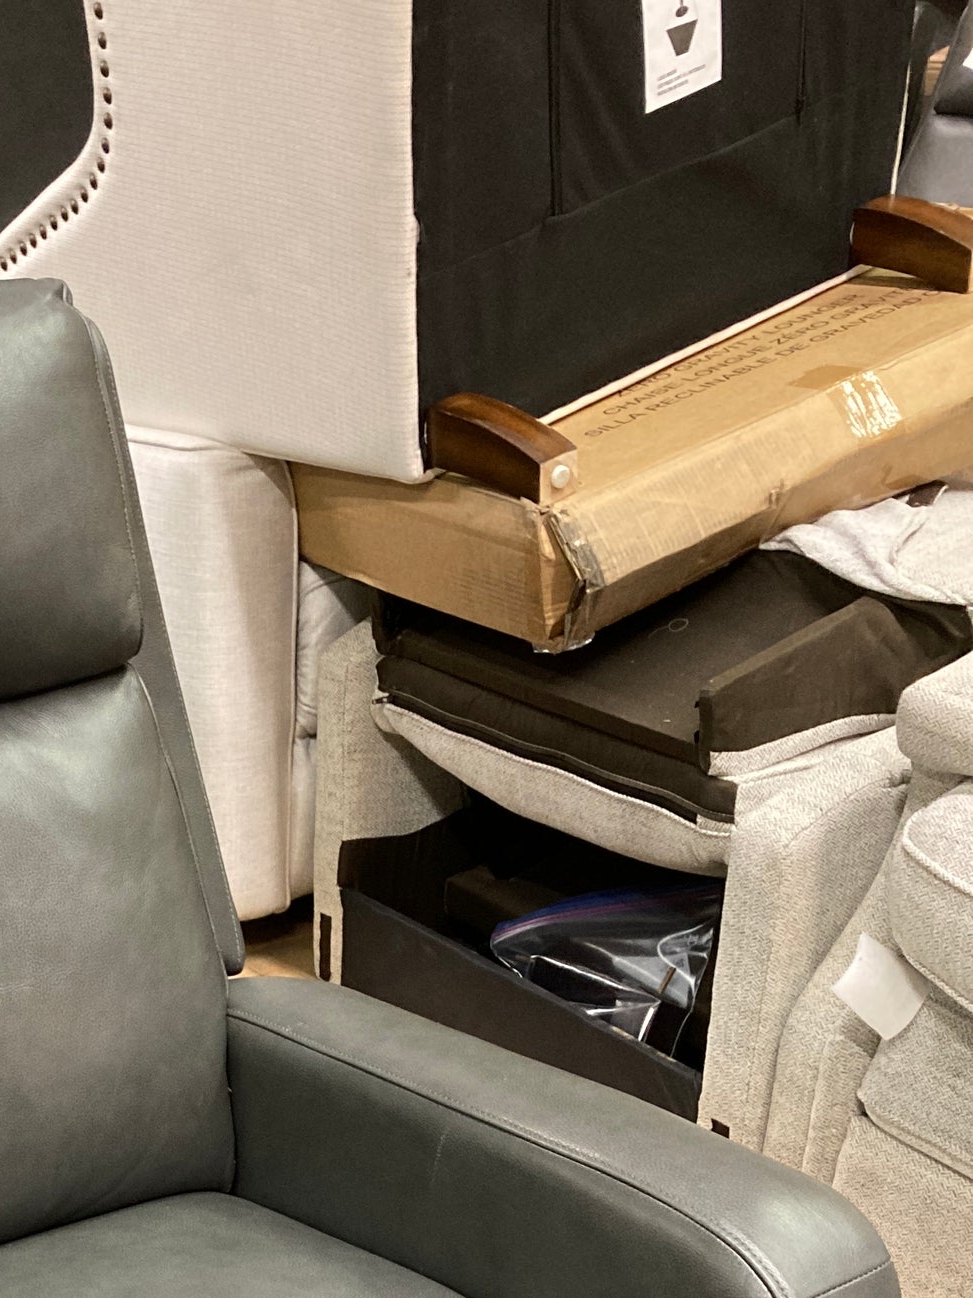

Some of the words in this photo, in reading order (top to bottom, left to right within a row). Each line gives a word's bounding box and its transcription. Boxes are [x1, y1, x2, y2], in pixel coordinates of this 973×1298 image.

[584, 412, 648, 437] SILLA
[646, 357, 777, 412] RECLINABLE
[775, 343, 810, 357] DE
[810, 297, 924, 343] GRAVEDAD
[674, 335, 759, 373] GRAVITY
[762, 293, 865, 335] LOUNGER
[603, 382, 683, 415] CHAISE
[683, 342, 770, 383] LONGUE
